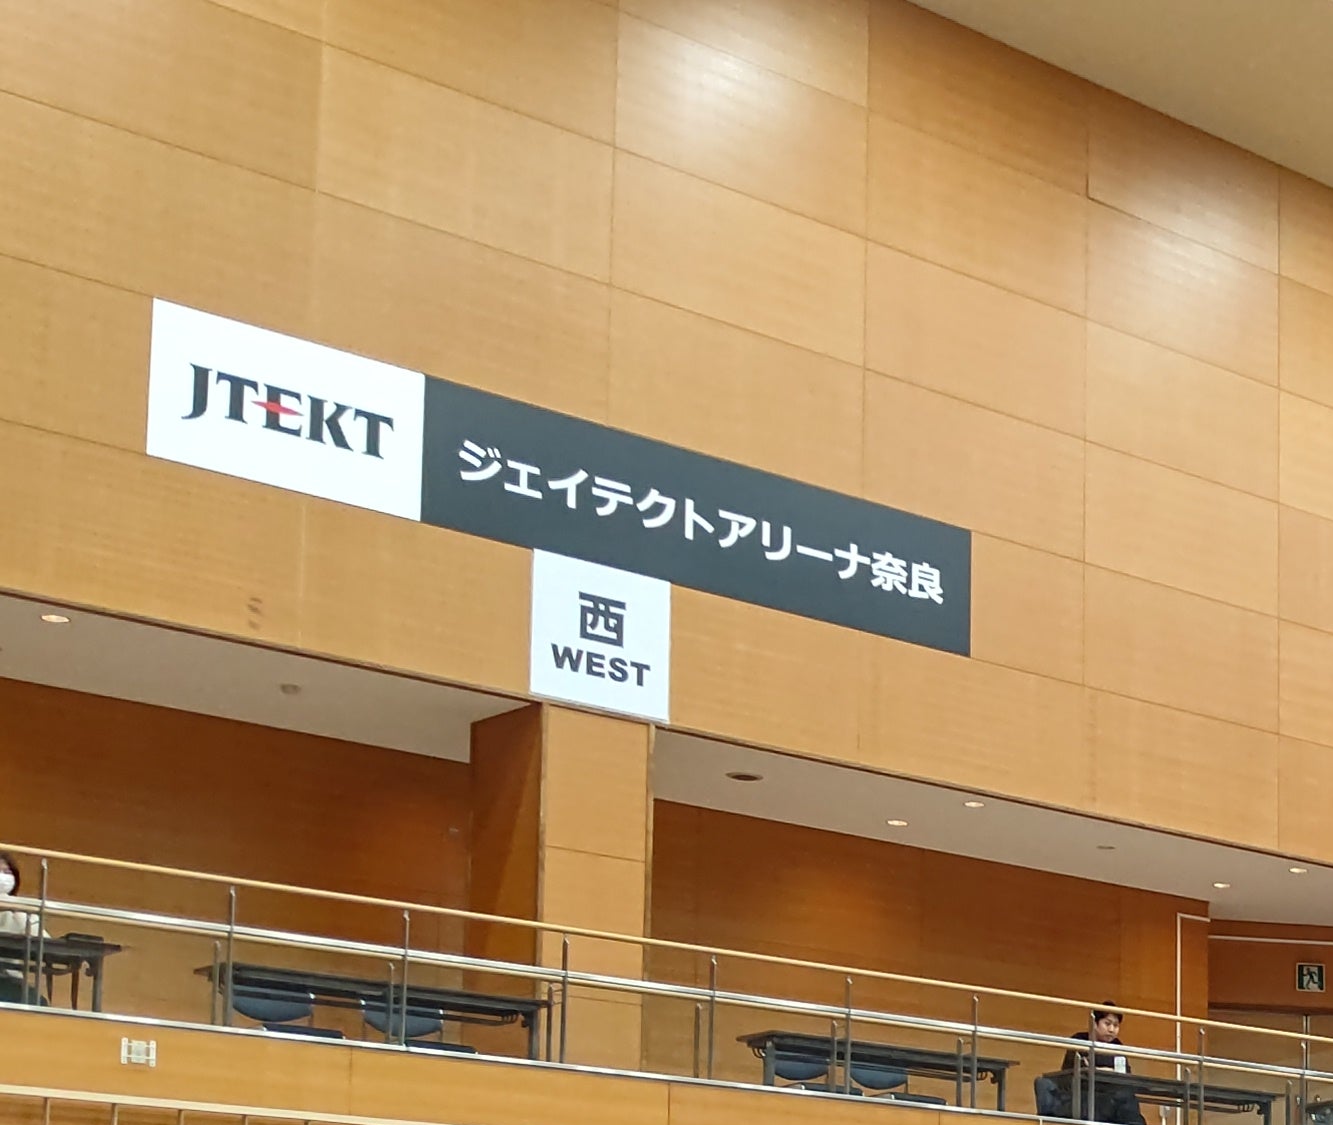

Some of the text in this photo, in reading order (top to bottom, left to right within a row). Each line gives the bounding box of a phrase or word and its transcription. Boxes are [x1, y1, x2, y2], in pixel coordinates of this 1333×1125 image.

[182, 363, 395, 462] JTEKT
[458, 439, 945, 605] ジェイテクトアリーナ奈良
[577, 591, 627, 650] 西
[551, 644, 651, 689] WEST
